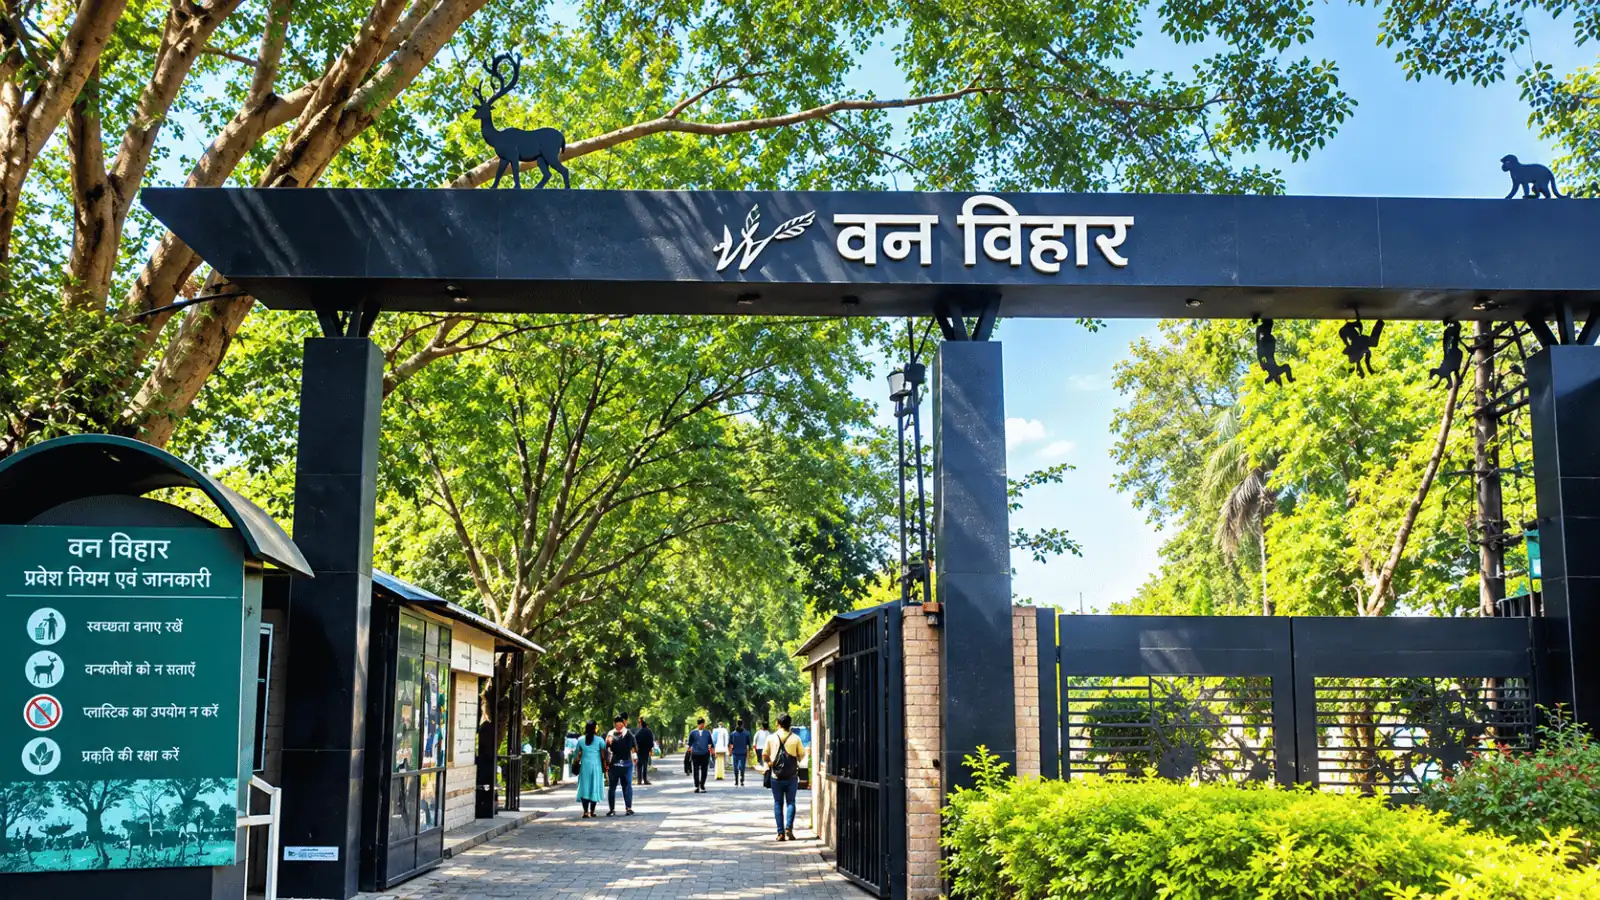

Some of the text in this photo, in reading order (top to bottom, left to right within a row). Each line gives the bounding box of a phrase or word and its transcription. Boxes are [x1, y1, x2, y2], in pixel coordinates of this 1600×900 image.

[833, 194, 1136, 274] वन विहार
[67, 531, 171, 562] वन विहार
[24, 565, 212, 590] प्रवेश नियम एवं जानकारी
[86, 621, 130, 633] स्वच्छता
[165, 617, 184, 634] रखें
[84, 660, 133, 676] वन्यजीवों
[135, 660, 151, 676] को
[154, 664, 163, 676] न
[132, 706, 148, 719] का
[189, 706, 199, 719] न
[200, 703, 220, 719] करें
[117, 746, 133, 762] की
[136, 749, 159, 763] रक्षा
[161, 746, 180, 762] करें
